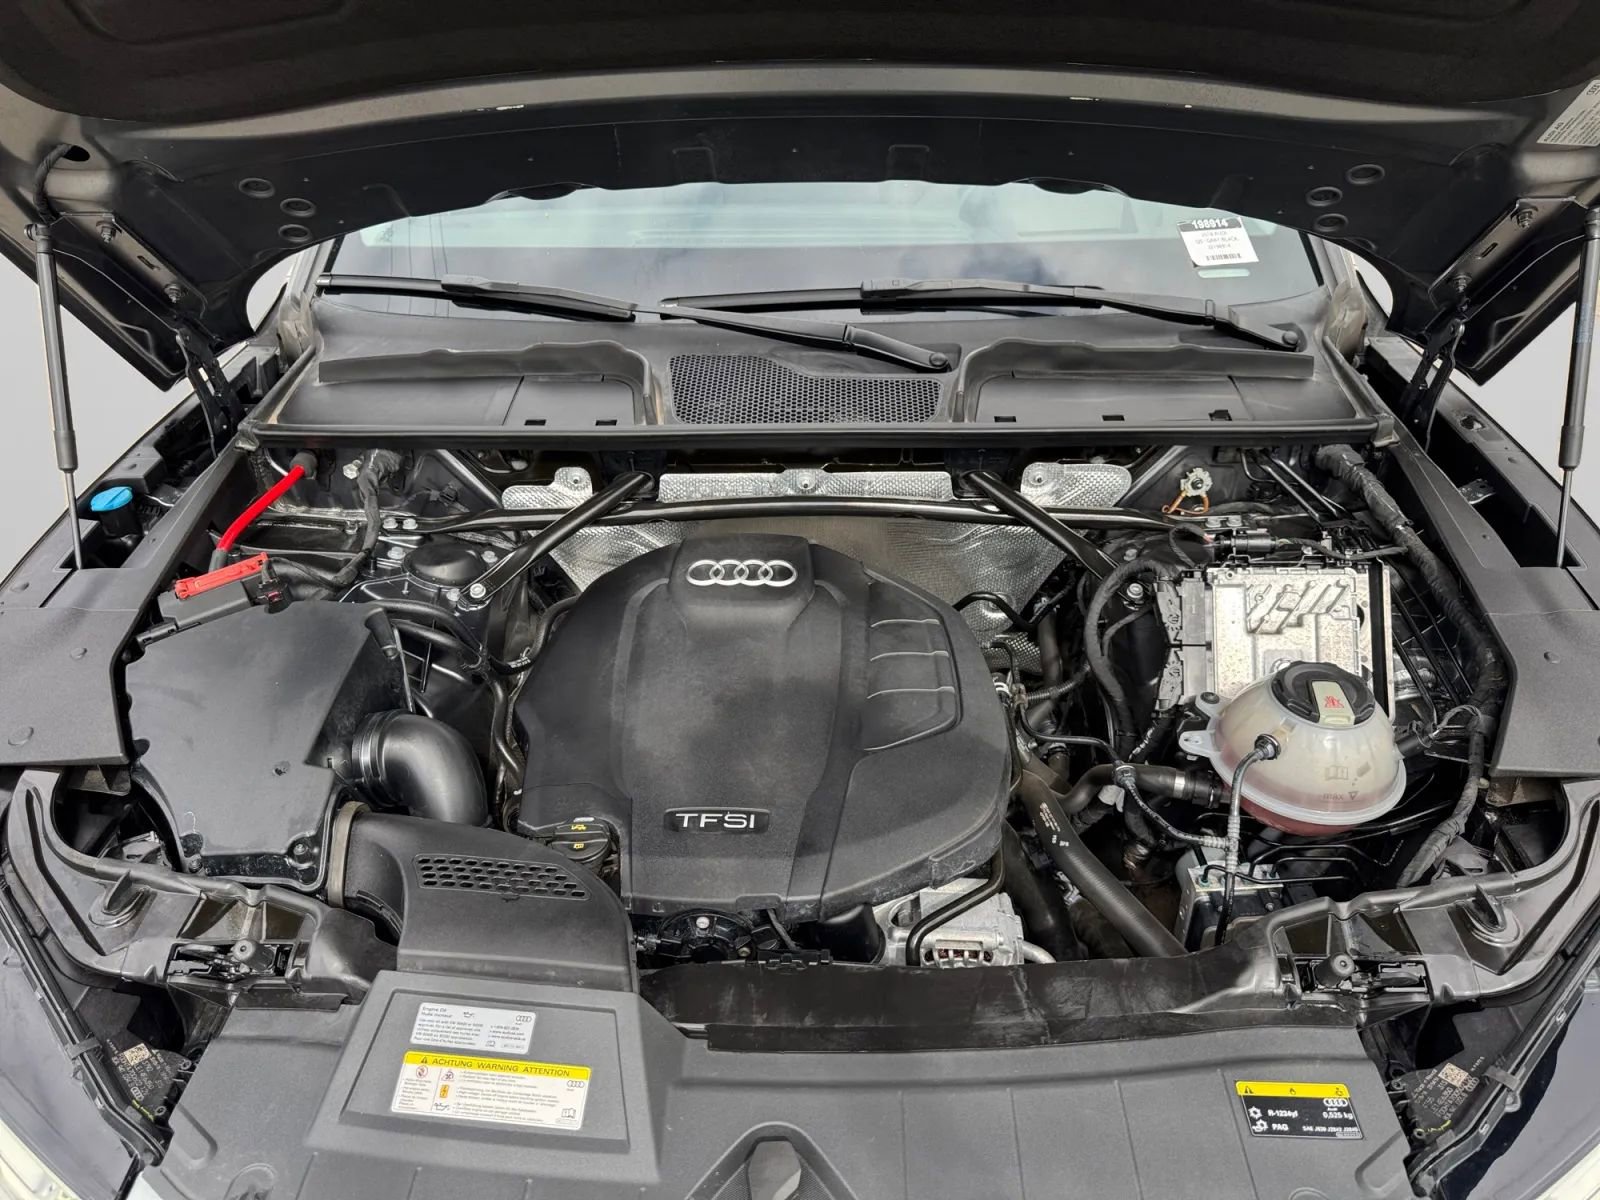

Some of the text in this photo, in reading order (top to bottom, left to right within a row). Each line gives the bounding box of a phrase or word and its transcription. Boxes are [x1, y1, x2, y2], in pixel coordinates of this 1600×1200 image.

[1191, 218, 1228, 229] 198914
[676, 813, 755, 829] TFSI
[431, 1058, 473, 1068] ACHTUNG
[477, 1062, 519, 1072] WARNING
[522, 1066, 570, 1077] ATTENTION
[1343, 1111, 1354, 1120] kg
[1271, 1123, 1289, 1131] PAG
